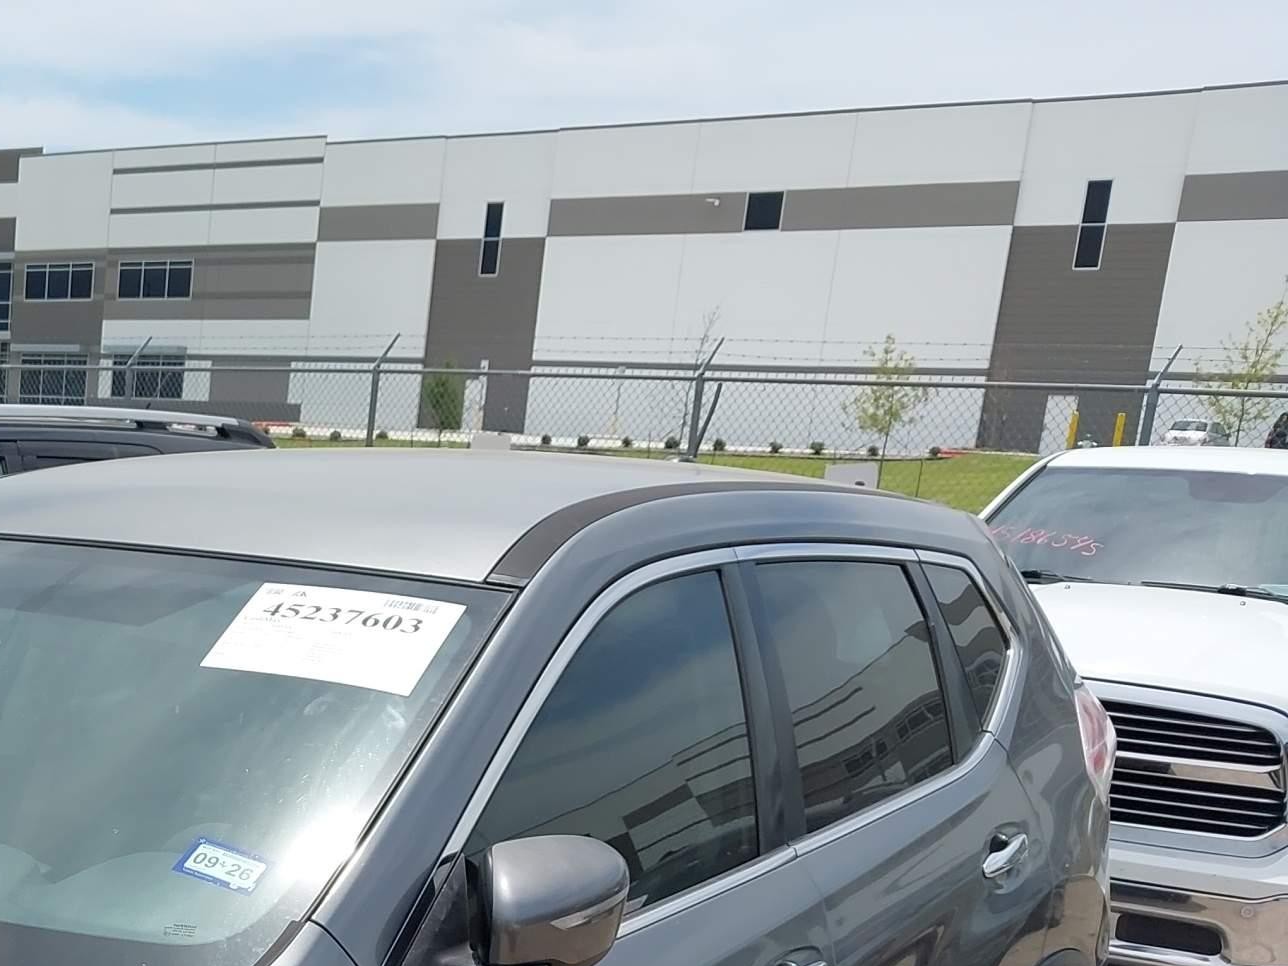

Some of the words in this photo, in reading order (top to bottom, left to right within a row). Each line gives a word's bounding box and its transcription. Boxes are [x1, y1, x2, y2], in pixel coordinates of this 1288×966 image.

[263, 601, 424, 635] 45237603
[192, 852, 220, 869] 09
[224, 863, 254, 881] 26
